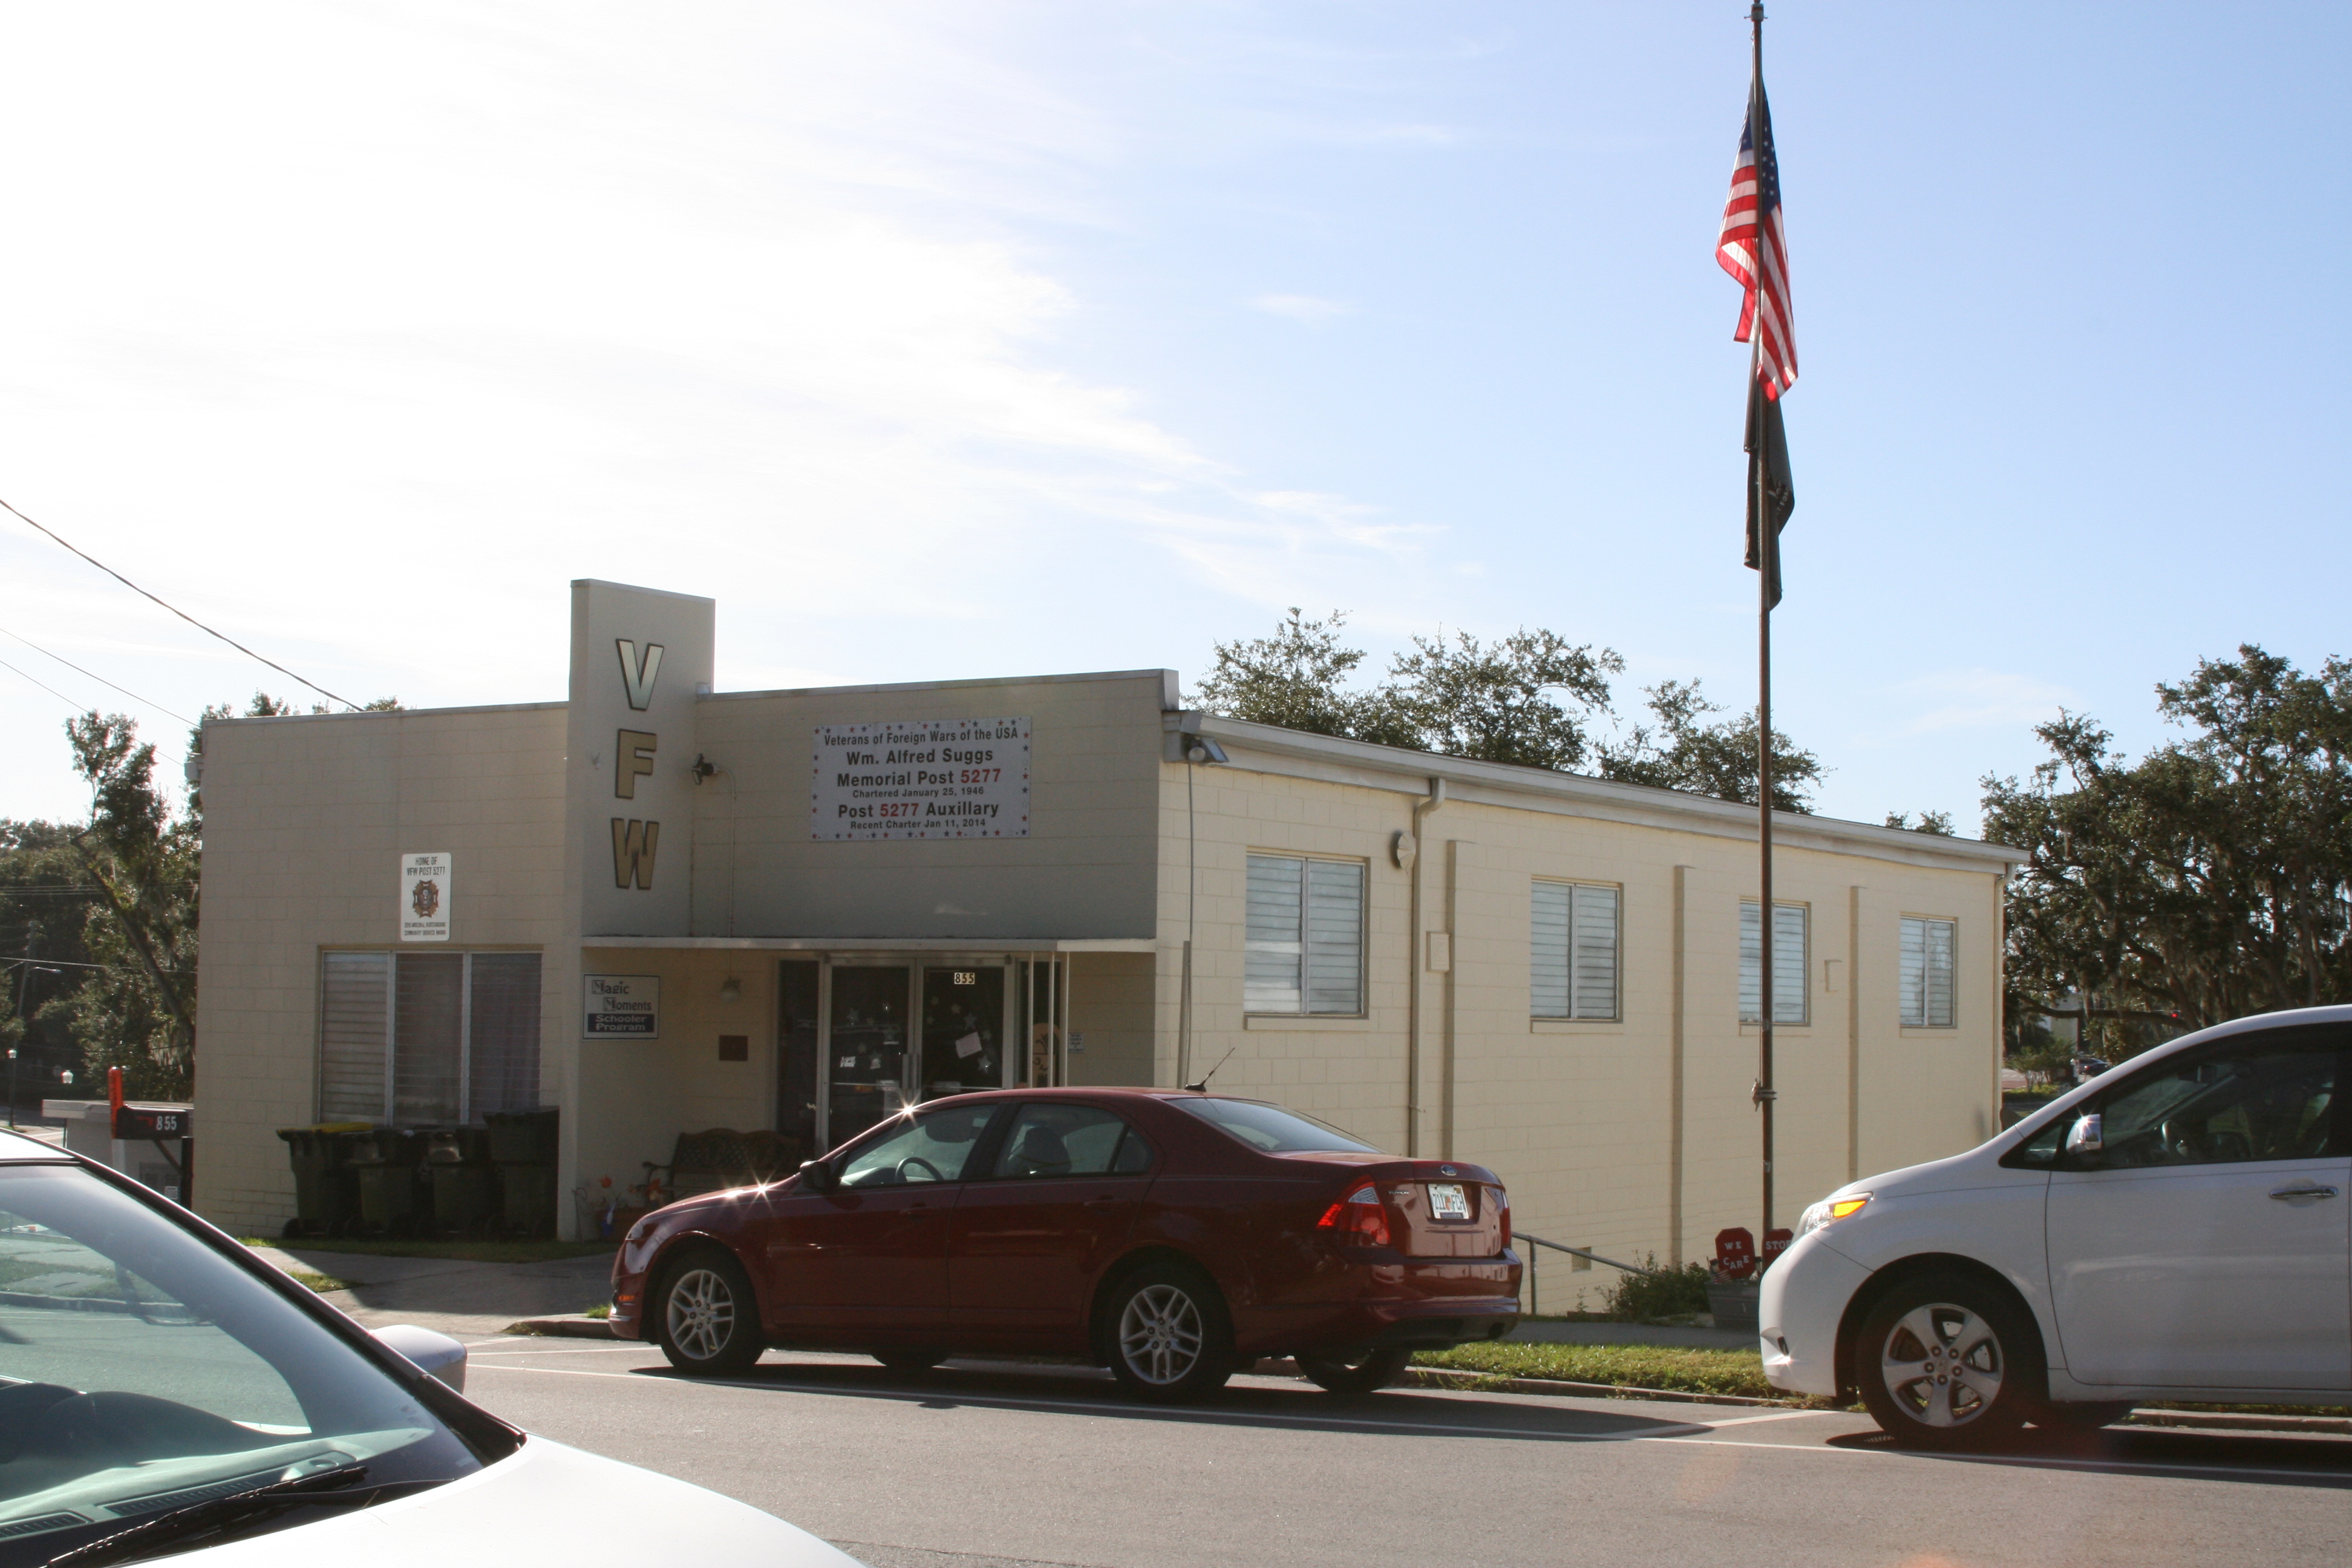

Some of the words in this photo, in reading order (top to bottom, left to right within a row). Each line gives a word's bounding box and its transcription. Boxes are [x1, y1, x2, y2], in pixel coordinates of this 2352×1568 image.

[825, 734, 869, 746] Veterans
[873, 733, 883, 744] of
[887, 732, 926, 745] Foreign
[930, 730, 956, 742] Wars
[960, 729, 971, 740] of
[975, 728, 991, 740] the
[996, 727, 1018, 739] USA
[847, 751, 879, 765] Wm.
[886, 749, 935, 764] Alfred
[942, 748, 993, 765] Suggs
[611, 638, 664, 890] VFW
[837, 772, 910, 787] Memorial
[918, 770, 954, 785] Post
[961, 768, 1001, 783] 5277
[853, 789, 898, 798] Chartered
[902, 788, 939, 798] January
[942, 788, 957, 797] 25,
[961, 786, 984, 795] 1946
[838, 805, 874, 818] Post
[880, 803, 919, 817] 5277
[926, 801, 999, 818] Auxillary
[851, 821, 883, 829] Recent
[886, 820, 921, 829] Charter
[945, 819, 959, 828] 11,
[962, 818, 986, 827] 2014
[416, 857, 430, 866] HOME
[419, 867, 432, 875] POST
[433, 866, 445, 875] 5277
[955, 973, 974, 984] 855
[596, 1014, 647, 1023] Schooler
[596, 1023, 645, 1031] Program
[157, 1116, 177, 1131] 855
[1724, 1241, 1742, 1250] WE
[1723, 1255, 1749, 1269] CARE
